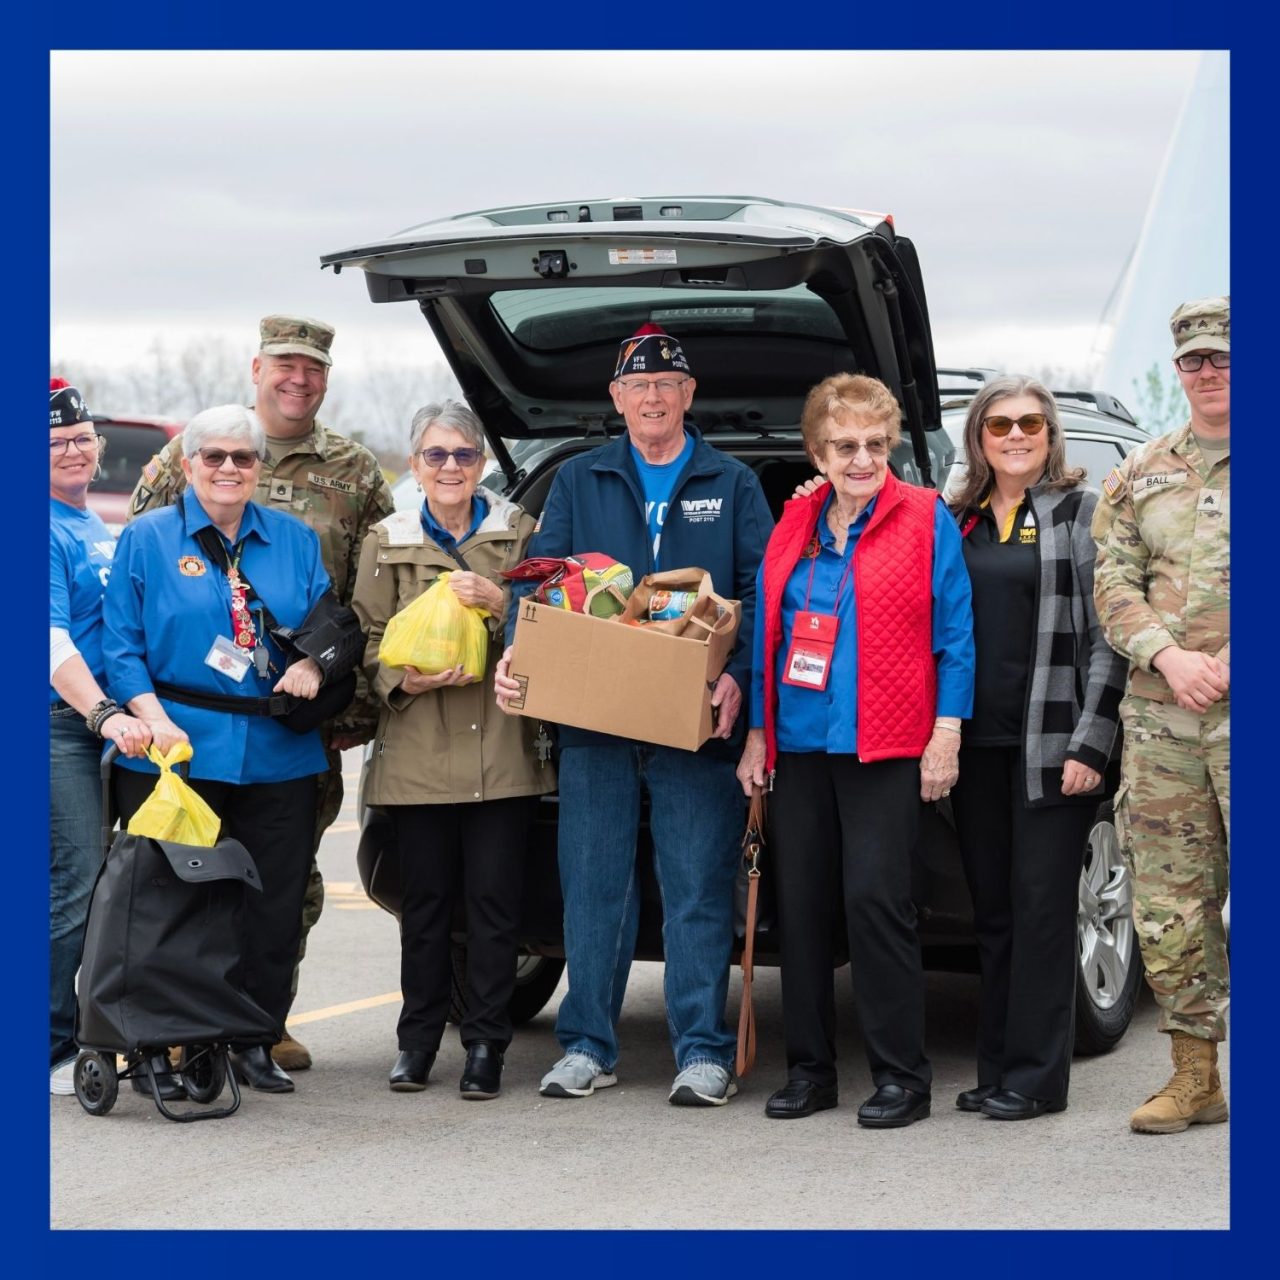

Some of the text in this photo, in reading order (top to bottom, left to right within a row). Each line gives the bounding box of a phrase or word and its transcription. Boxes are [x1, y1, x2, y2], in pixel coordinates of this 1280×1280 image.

[633, 355, 646, 363] VFW
[313, 475, 352, 491] U.S. ARMY
[1146, 476, 1169, 487] BALL
[680, 498, 723, 511] VFW
